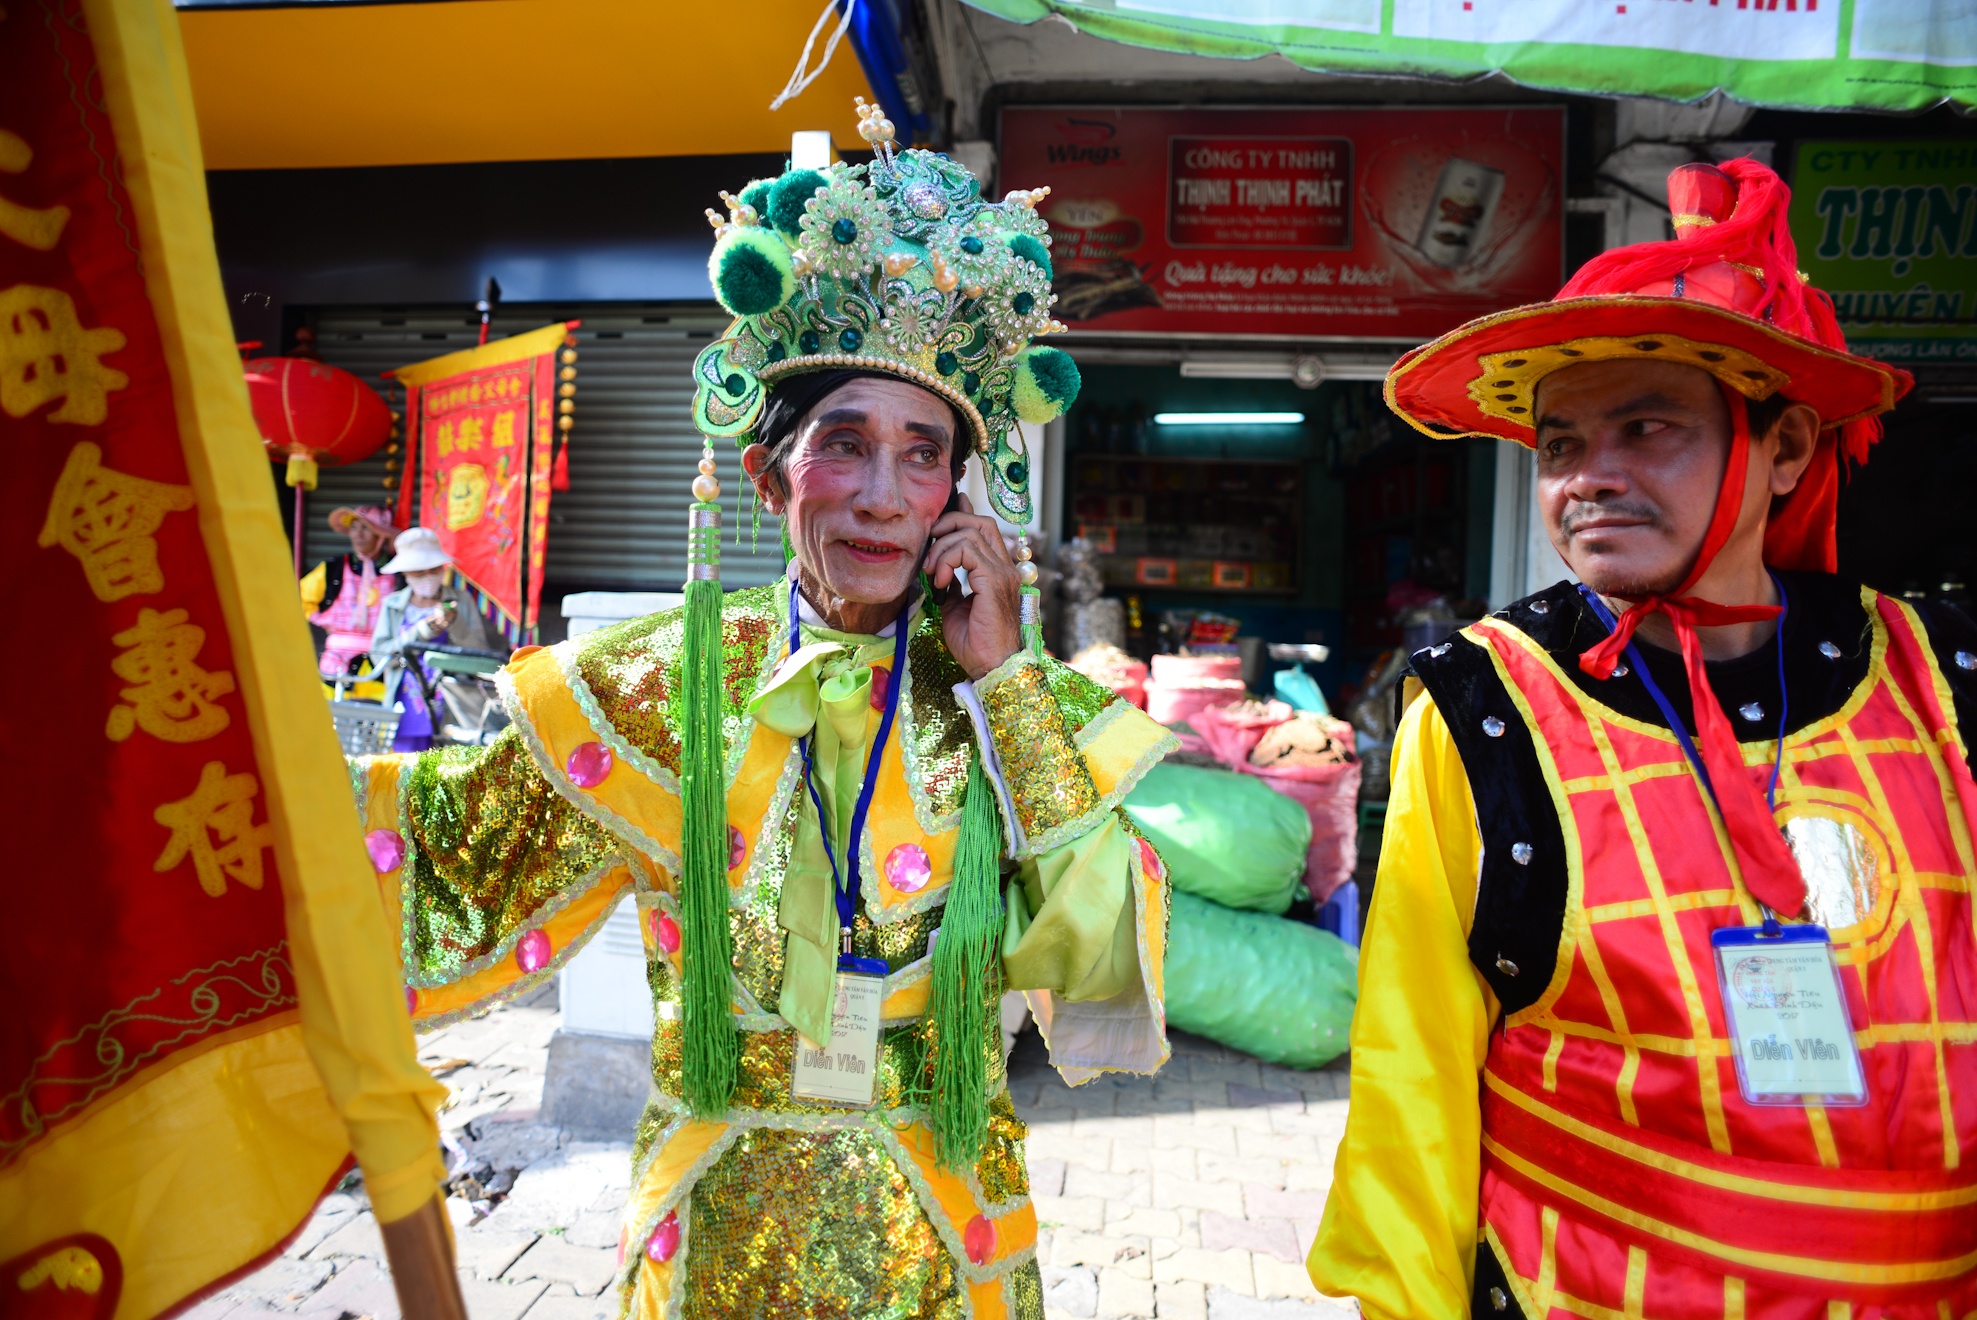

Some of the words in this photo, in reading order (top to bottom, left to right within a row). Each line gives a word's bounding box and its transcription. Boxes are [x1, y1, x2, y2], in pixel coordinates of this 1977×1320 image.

[1047, 143, 1121, 165] Wings
[1185, 146, 1243, 169] CÔNG
[1246, 150, 1274, 169] TY
[1278, 149, 1335, 169] TNHH
[1811, 151, 1880, 172] CTY
[1894, 149, 1977, 170] TNH
[1176, 178, 1231, 212] THỊNH
[1235, 178, 1291, 212] THỊNH
[1295, 171, 1344, 207] PHÁT
[1164, 259, 1206, 287] Quà
[1260, 263, 1298, 285] cho
[1751, 1034, 1793, 1060] Diễn
[1794, 1038, 1840, 1060] Viên
[803, 1047, 833, 1070] Diễn
[837, 1053, 866, 1074] Viên
